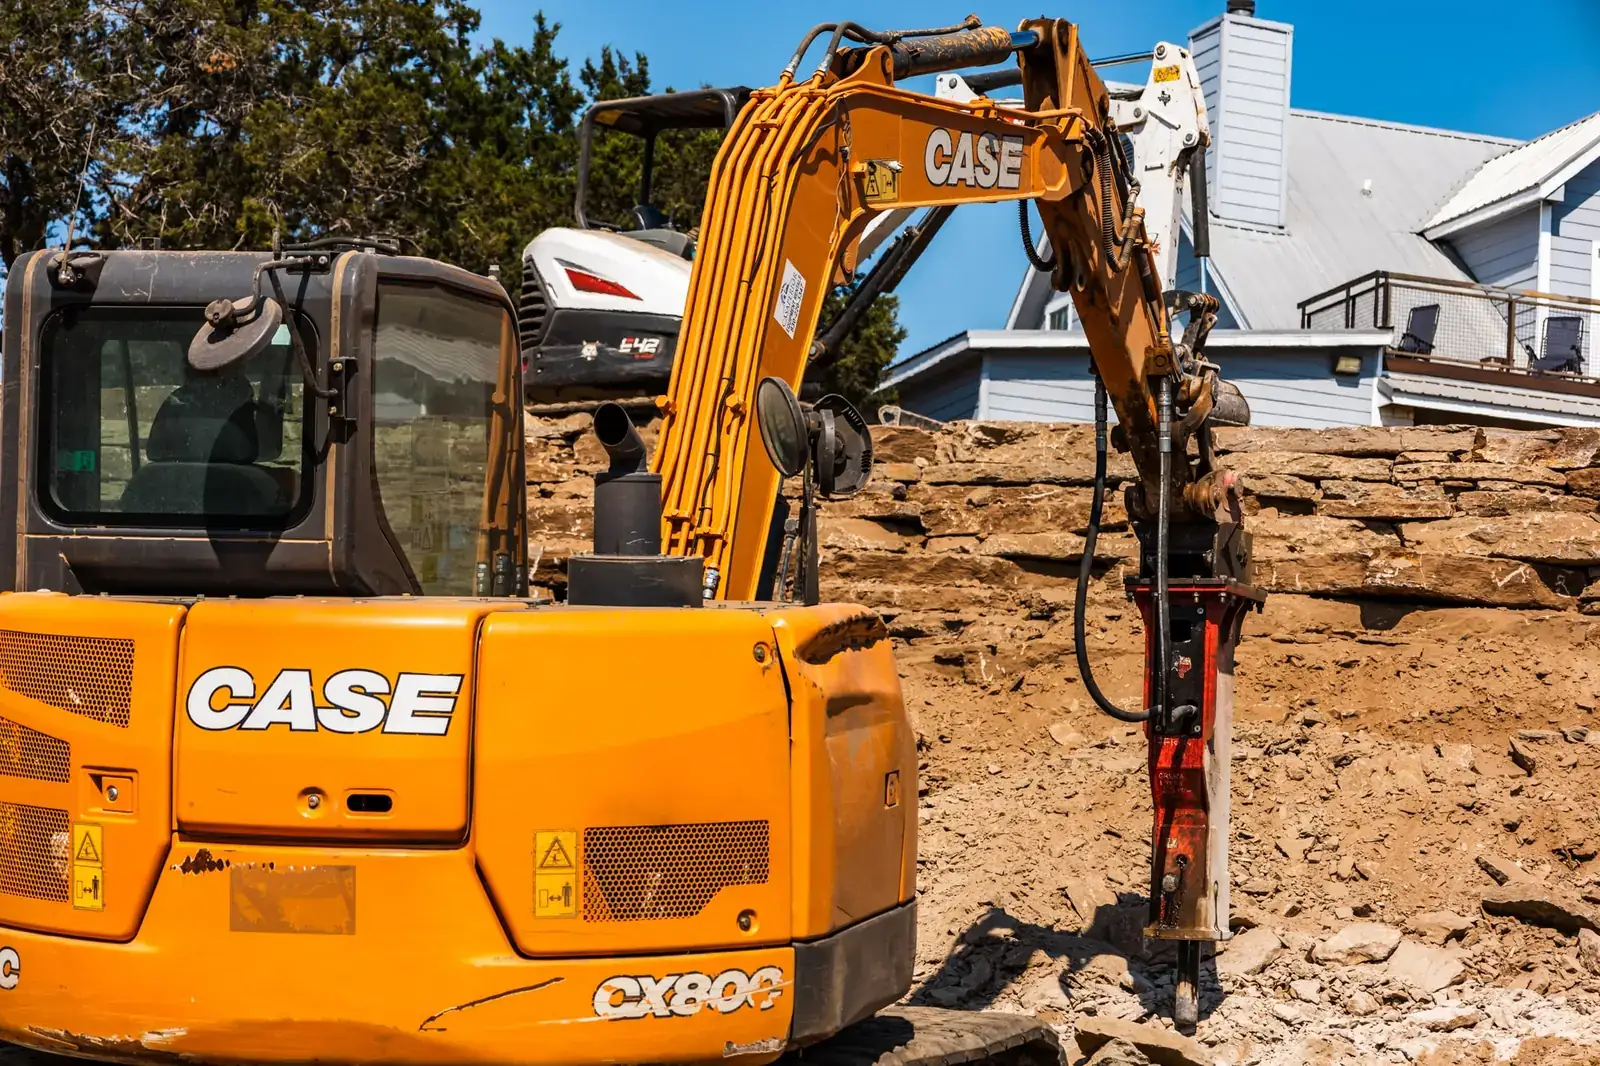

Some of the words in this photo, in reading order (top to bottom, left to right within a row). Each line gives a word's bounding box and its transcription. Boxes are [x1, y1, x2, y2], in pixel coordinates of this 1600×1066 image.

[924, 127, 1024, 189] CASE
[618, 336, 660, 353] E42
[186, 665, 465, 736] CASE
